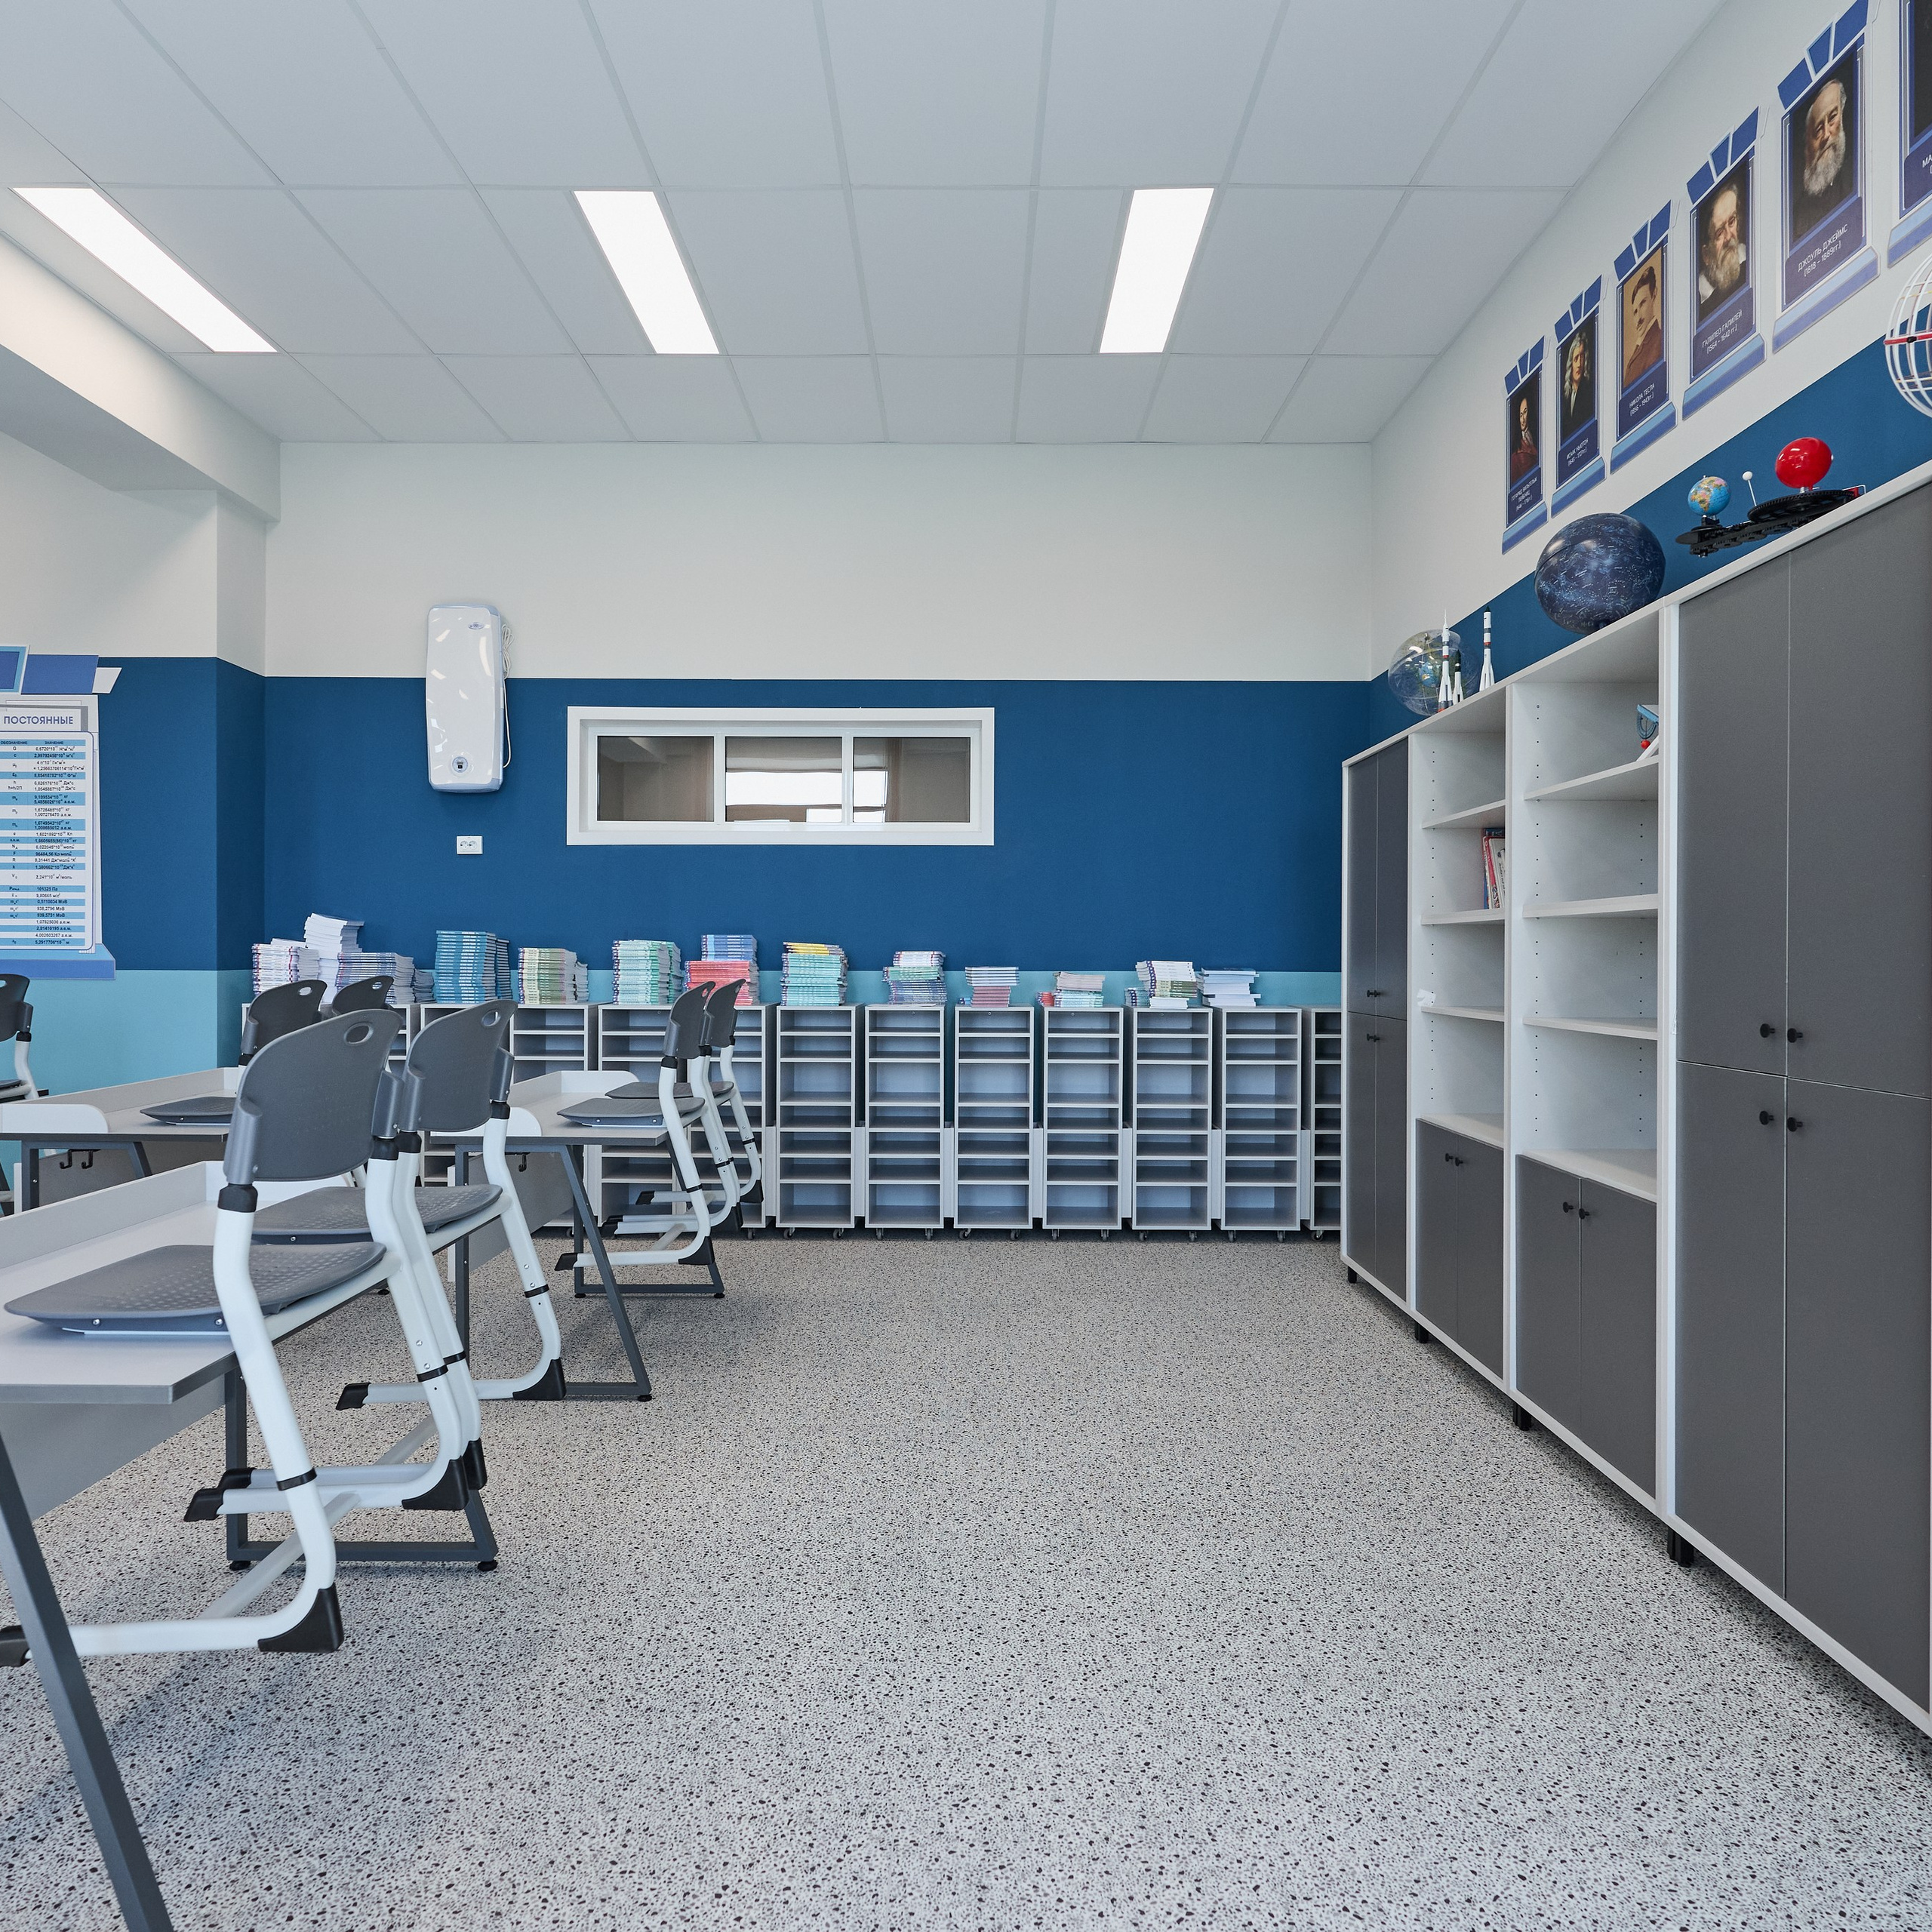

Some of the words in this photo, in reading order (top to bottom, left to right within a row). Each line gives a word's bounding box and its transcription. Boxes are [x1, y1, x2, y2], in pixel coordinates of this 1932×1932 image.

[1798, 248, 1822, 273] ДЖОУЛЬ
[1822, 223, 1848, 252] ДЖЕЙМС
[1702, 328, 1722, 348] ГАЛИЛЕО
[1721, 309, 1743, 331] ГАЛИЛЕЙ
[4, 715, 73, 724] ПОСТОЯННЫЕ
